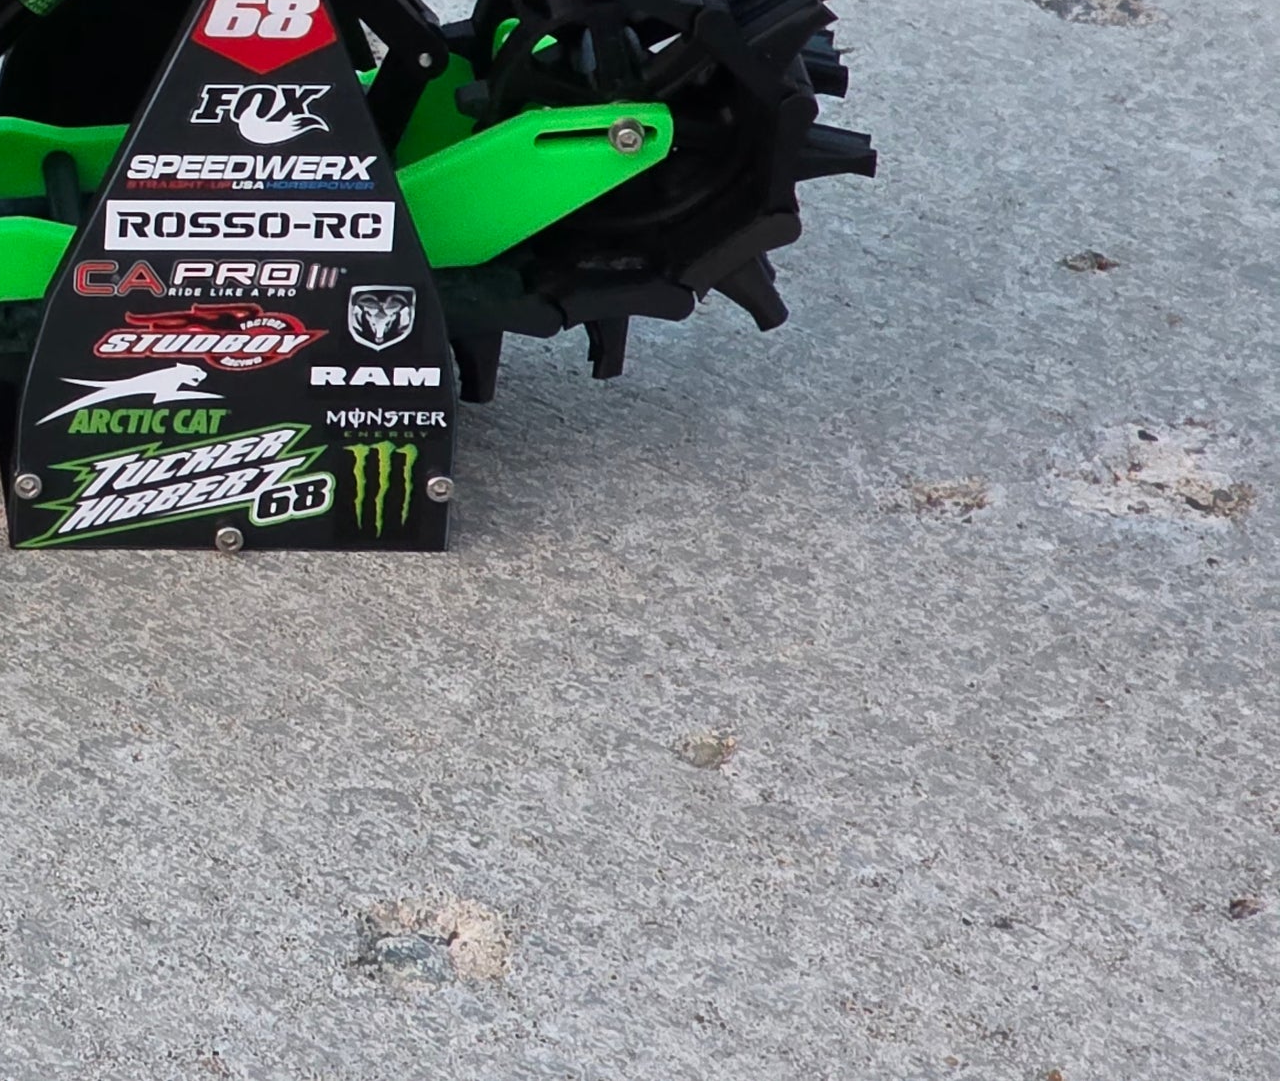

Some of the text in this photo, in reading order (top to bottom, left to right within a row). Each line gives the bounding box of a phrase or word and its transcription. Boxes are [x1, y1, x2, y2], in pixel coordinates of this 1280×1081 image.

[191, 85, 331, 141] FOX
[127, 155, 377, 180] SPEEDWERX
[232, 181, 264, 190] USA
[266, 180, 375, 190] HORSEPOWER
[117, 211, 382, 239] ROSSO-RC
[171, 260, 303, 287] PRO
[168, 288, 297, 298] RIDE LIKE A PRO
[99, 334, 309, 354] STUDBOY
[310, 366, 441, 387] RAM
[68, 408, 227, 434] ARCTIC CAT
[344, 430, 428, 438] ENERGY
[83, 430, 296, 497] TUCKER
[58, 457, 330, 534] HIBBERT 68
